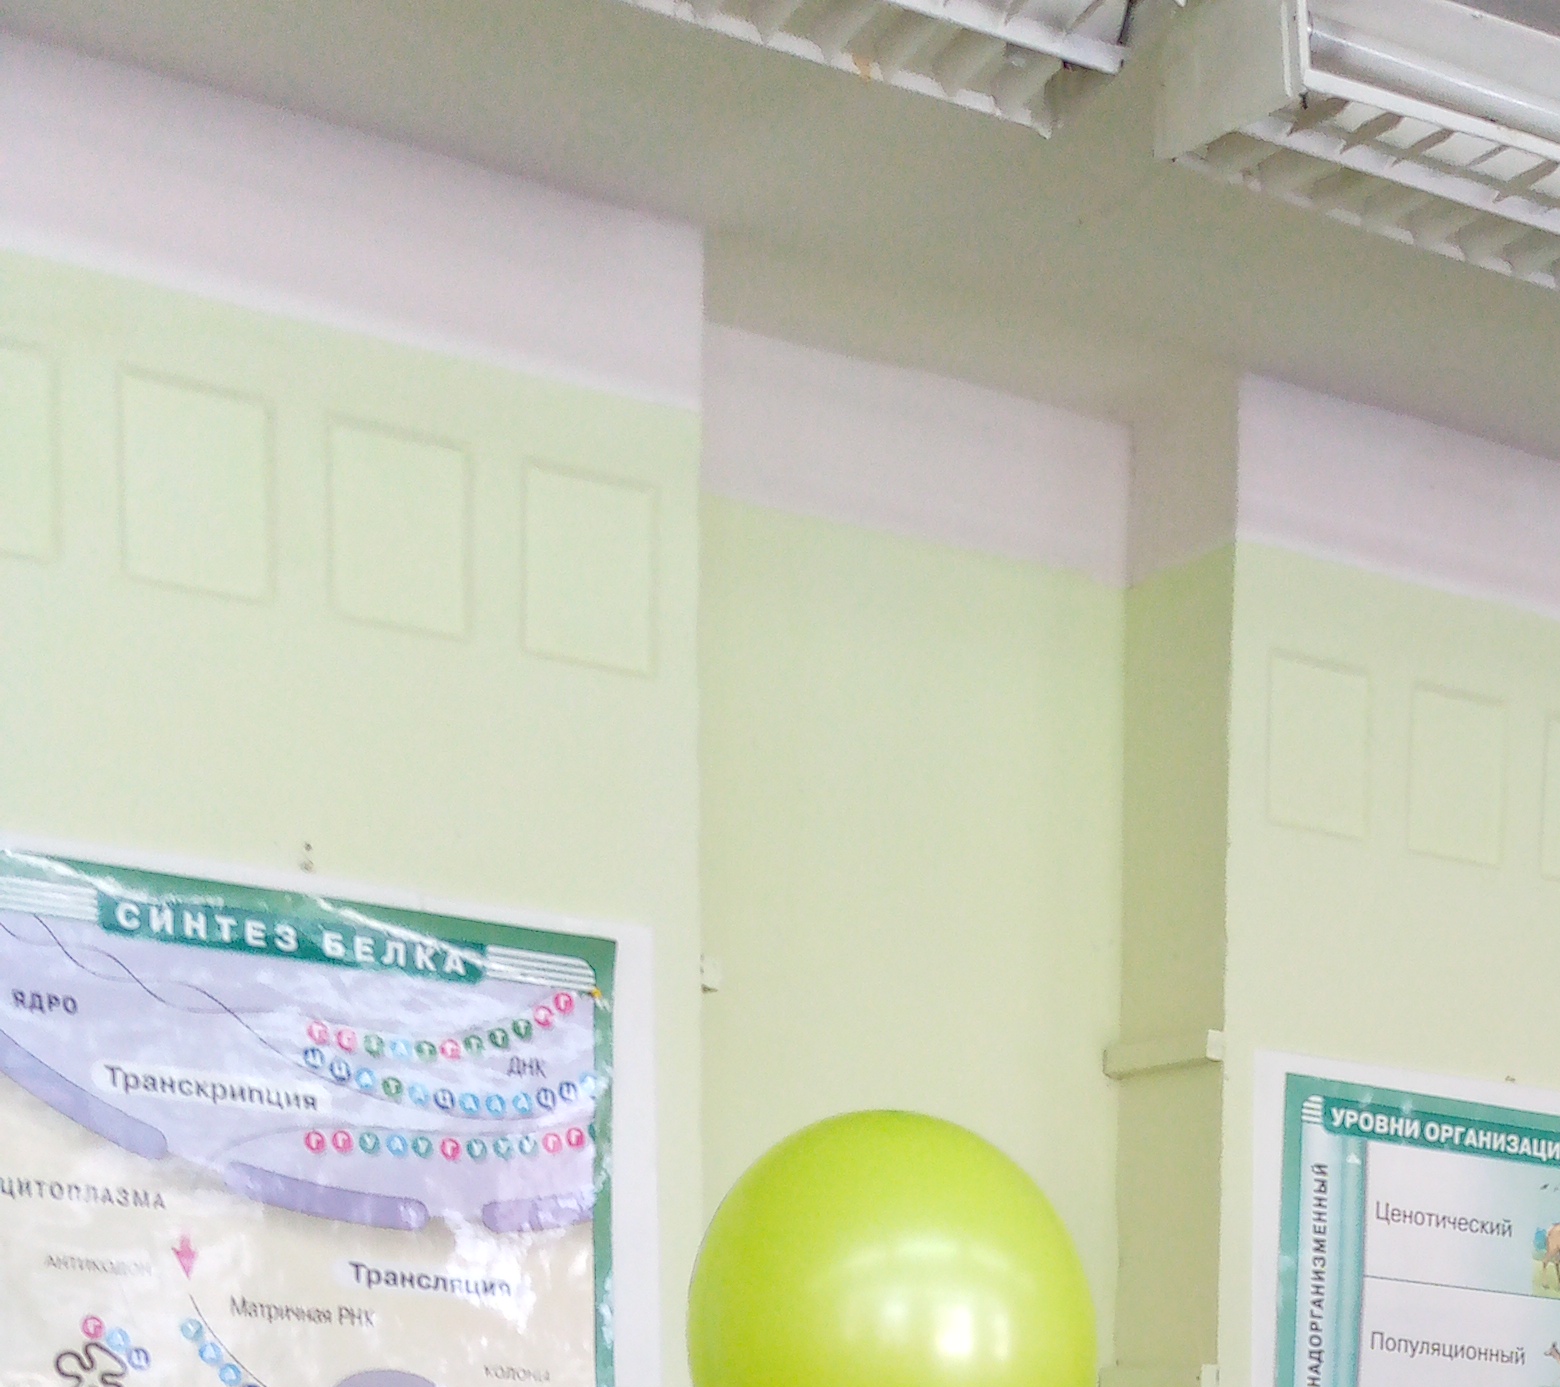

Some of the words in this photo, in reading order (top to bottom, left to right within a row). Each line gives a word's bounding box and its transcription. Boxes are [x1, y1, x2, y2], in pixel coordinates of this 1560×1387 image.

[114, 900, 300, 954] СИНТЕЗ
[322, 925, 470, 978] БЕЛКА
[11, 988, 79, 1015] ЯДРО
[506, 1055, 547, 1078] ДНК
[104, 1063, 318, 1111] Транскрипция
[1330, 1107, 1421, 1140] УРОВНИ
[0, 1177, 167, 1210] ЦИТОПЛАЗМА
[1375, 1201, 1514, 1238] Ценотический
[337, 1304, 376, 1328] РНК
[1370, 1330, 1527, 1367] Популяционный
